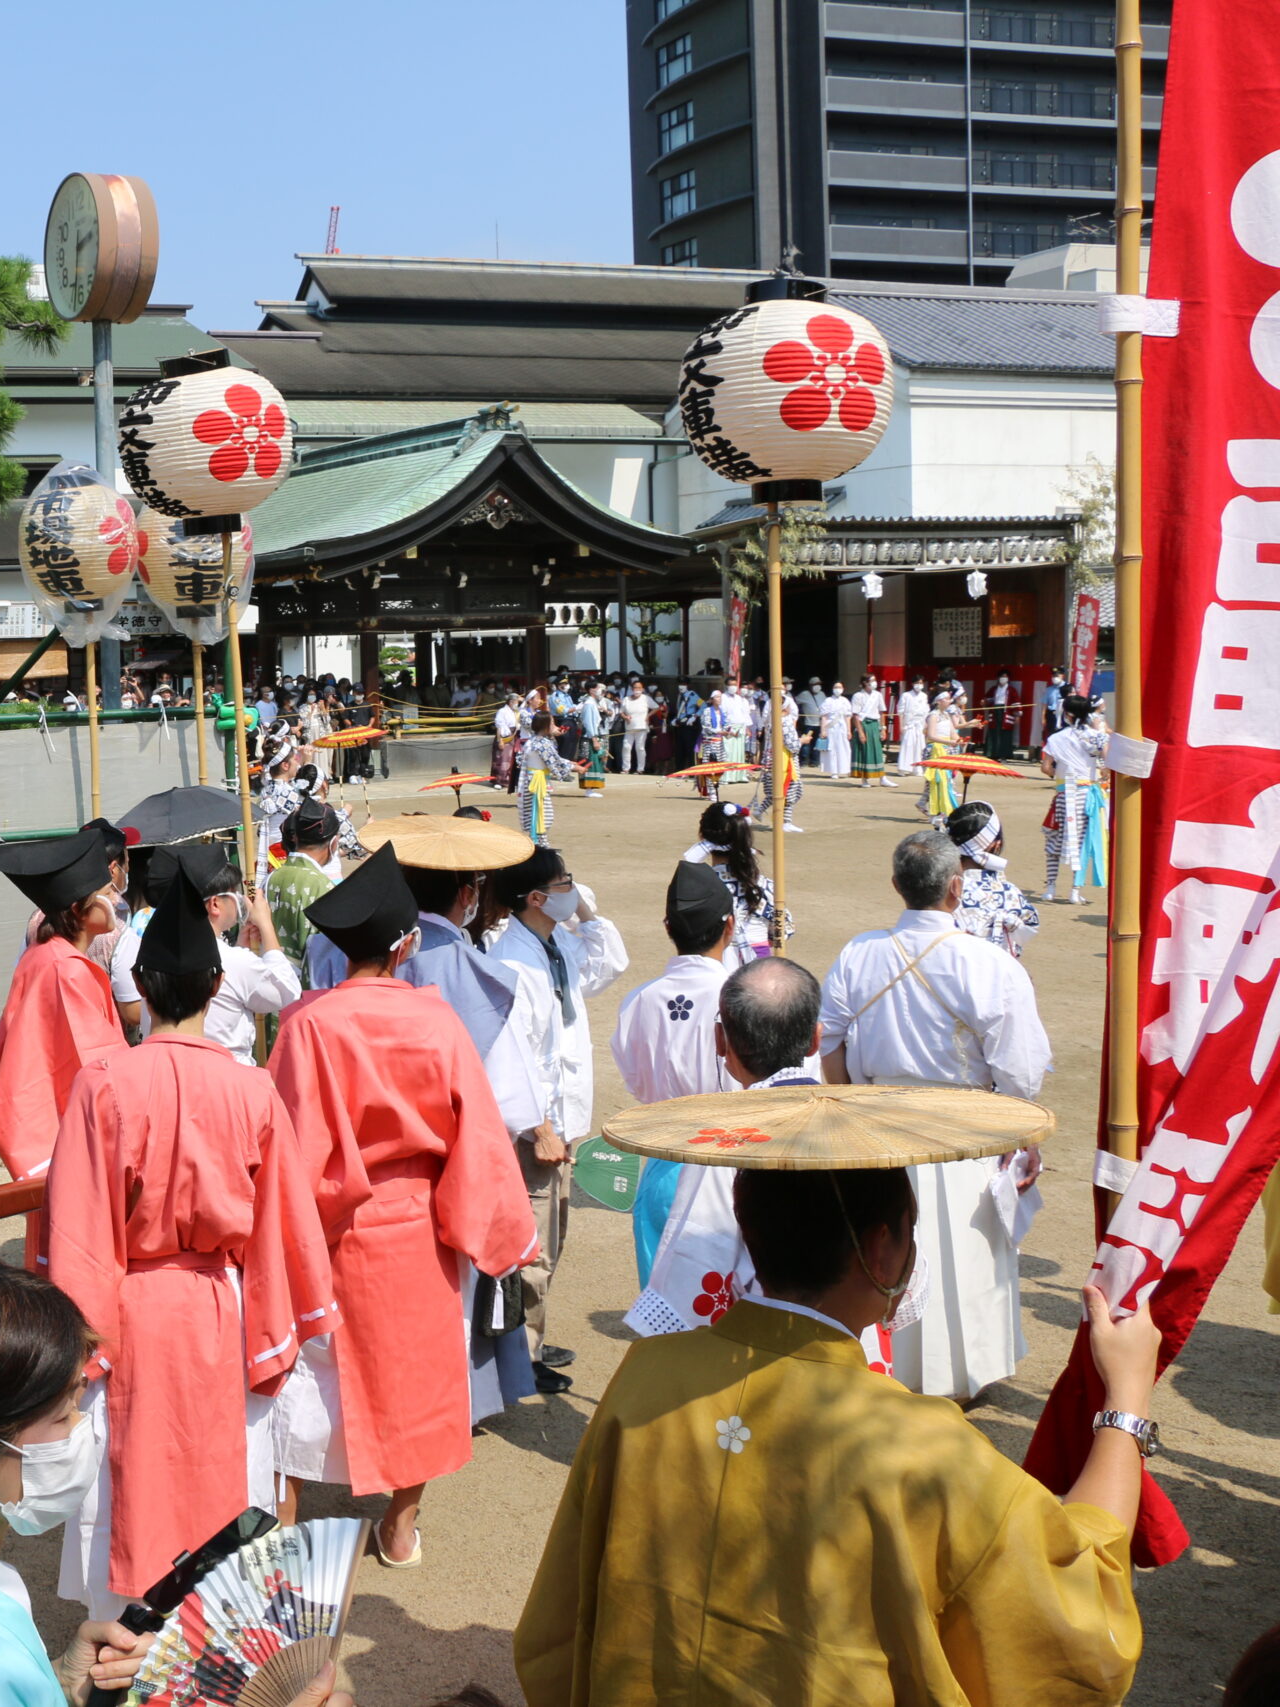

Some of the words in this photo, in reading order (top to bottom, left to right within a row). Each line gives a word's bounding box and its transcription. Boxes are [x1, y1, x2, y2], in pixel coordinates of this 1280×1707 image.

[58, 221, 69, 243] 10
[25, 490, 94, 597] 市場地車
